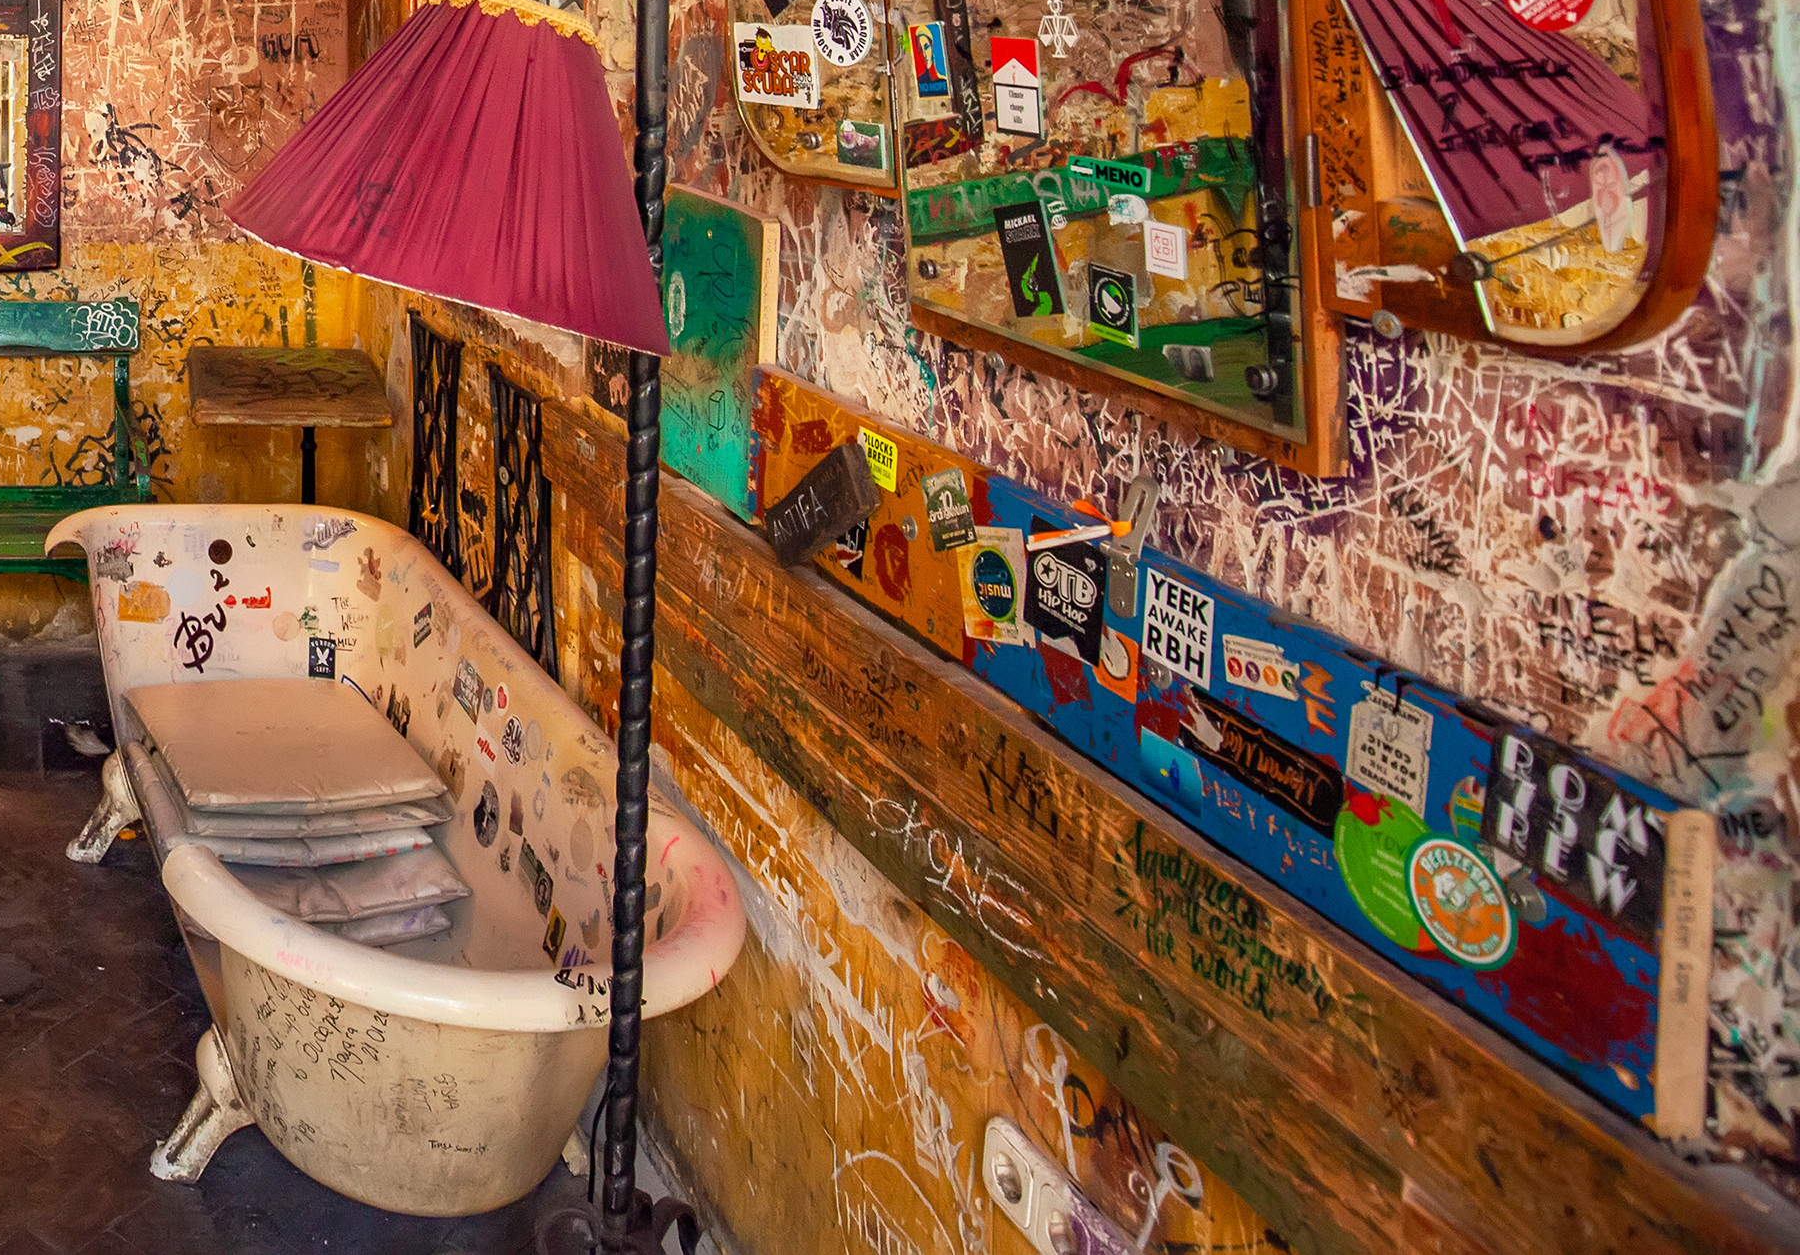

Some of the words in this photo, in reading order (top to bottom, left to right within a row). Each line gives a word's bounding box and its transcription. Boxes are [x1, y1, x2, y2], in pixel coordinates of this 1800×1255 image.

[1094, 164, 1143, 188] MENO
[1004, 214, 1037, 230] MICKAEL
[1005, 225, 1041, 243] STARK
[863, 432, 894, 457] OLLOCKS
[867, 448, 894, 470] BREXIT
[938, 490, 953, 511] 10
[771, 491, 829, 544] ANTIFA
[1034, 551, 1097, 610] OTB
[1149, 570, 1210, 626] YEEK
[1147, 600, 1209, 649] AWAKE
[1145, 622, 1207, 681] RBH
[1366, 733, 1412, 765] COMIC
[1381, 752, 1417, 781] POPE
[1359, 765, 1413, 802] APPROVED
